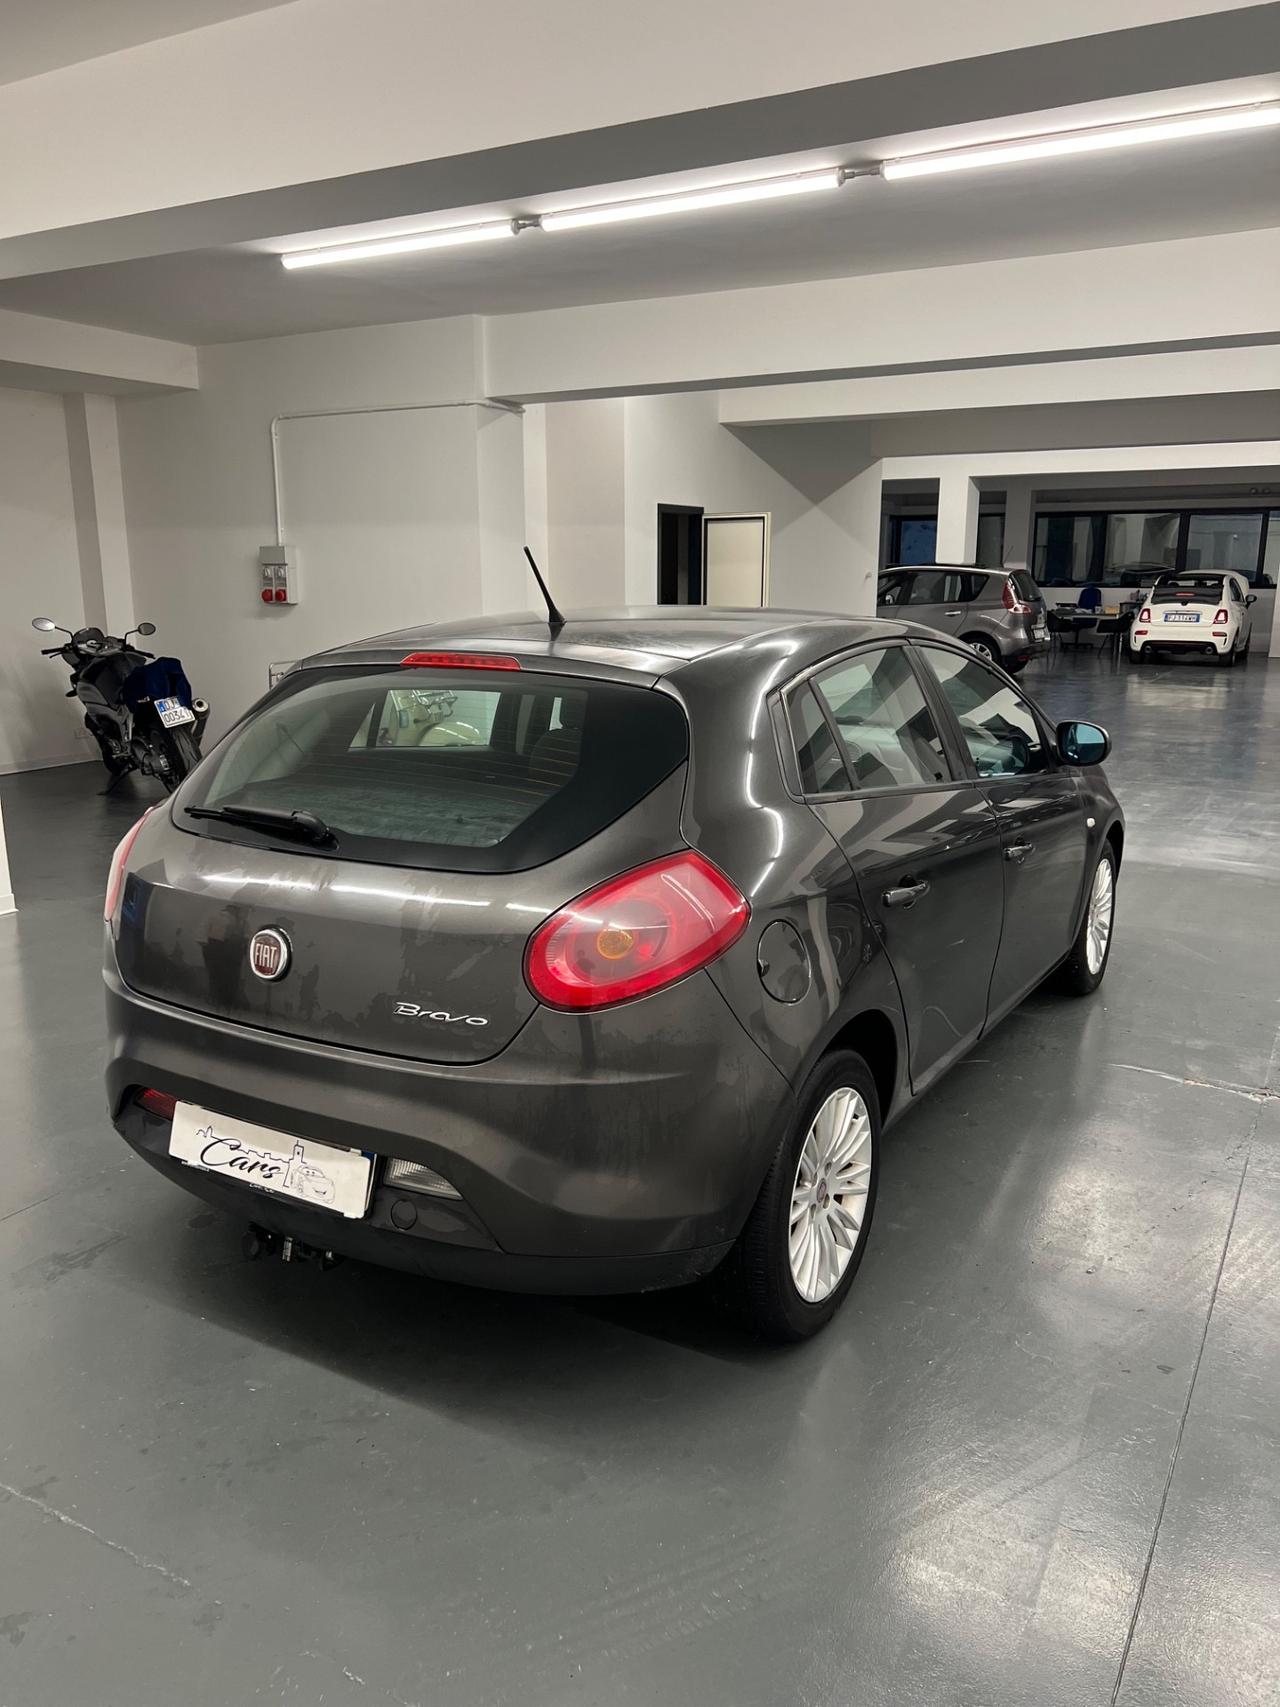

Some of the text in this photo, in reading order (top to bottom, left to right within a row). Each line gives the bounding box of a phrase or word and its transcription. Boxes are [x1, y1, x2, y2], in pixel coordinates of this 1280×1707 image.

[254, 943, 278, 969] FIAT
[393, 1001, 488, 1026] Bravo
[200, 1137, 284, 1179] Cars
